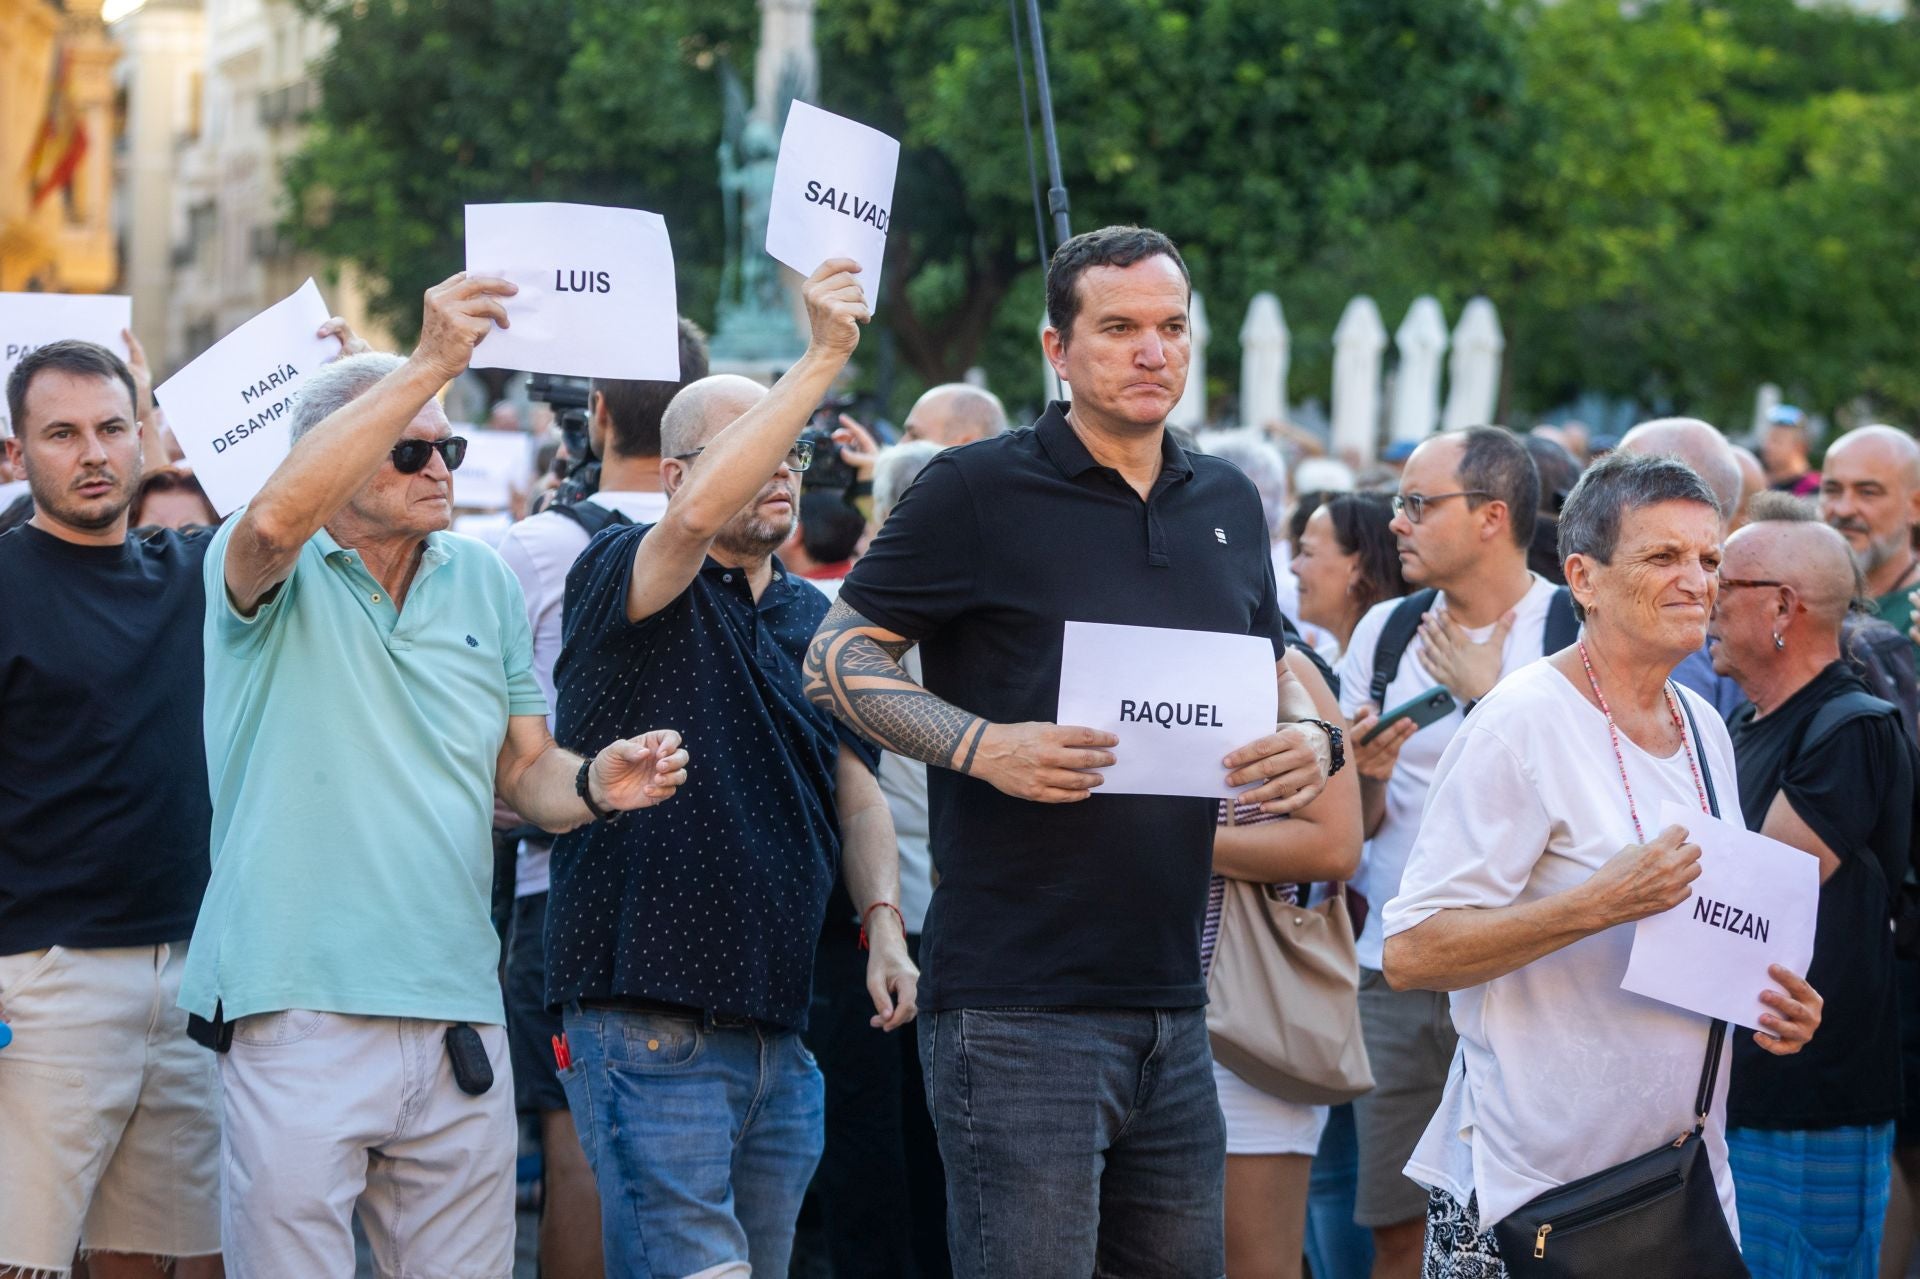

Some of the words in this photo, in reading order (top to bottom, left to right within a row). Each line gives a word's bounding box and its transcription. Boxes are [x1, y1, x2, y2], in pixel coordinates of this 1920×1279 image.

[555, 269, 611, 293] LUIS
[241, 364, 299, 404] MARÍA
[1119, 699, 1223, 729] RAQUEL
[1693, 896, 1770, 943] NEIZAN
